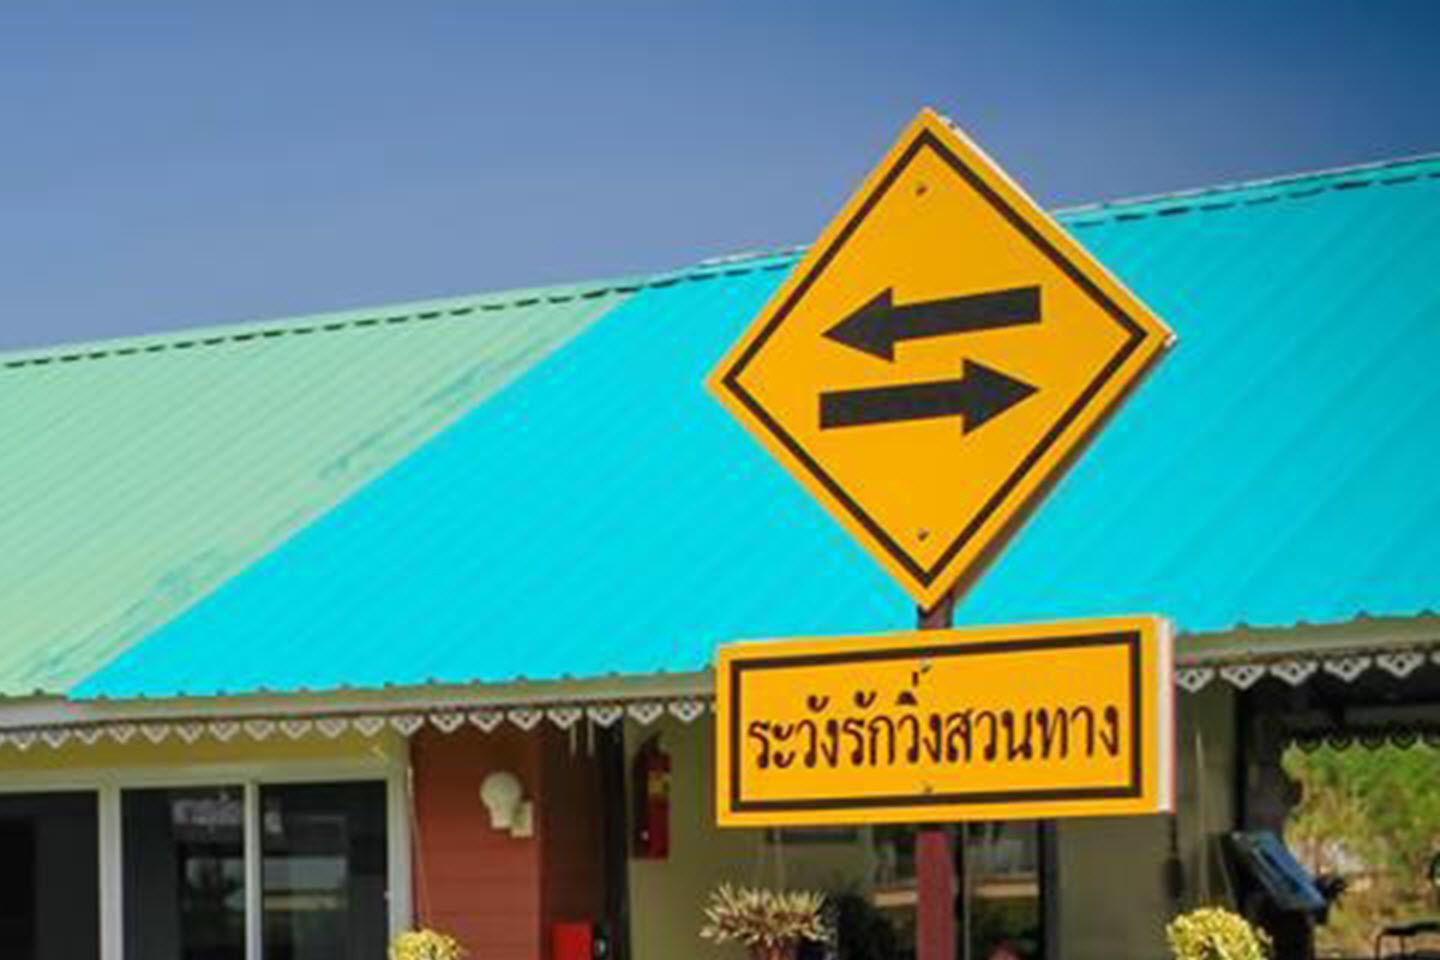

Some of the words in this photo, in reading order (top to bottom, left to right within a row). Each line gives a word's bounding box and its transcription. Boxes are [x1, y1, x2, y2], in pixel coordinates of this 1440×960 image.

[748, 671, 1120, 770] ระวังรักวิ่งสวนทาง
